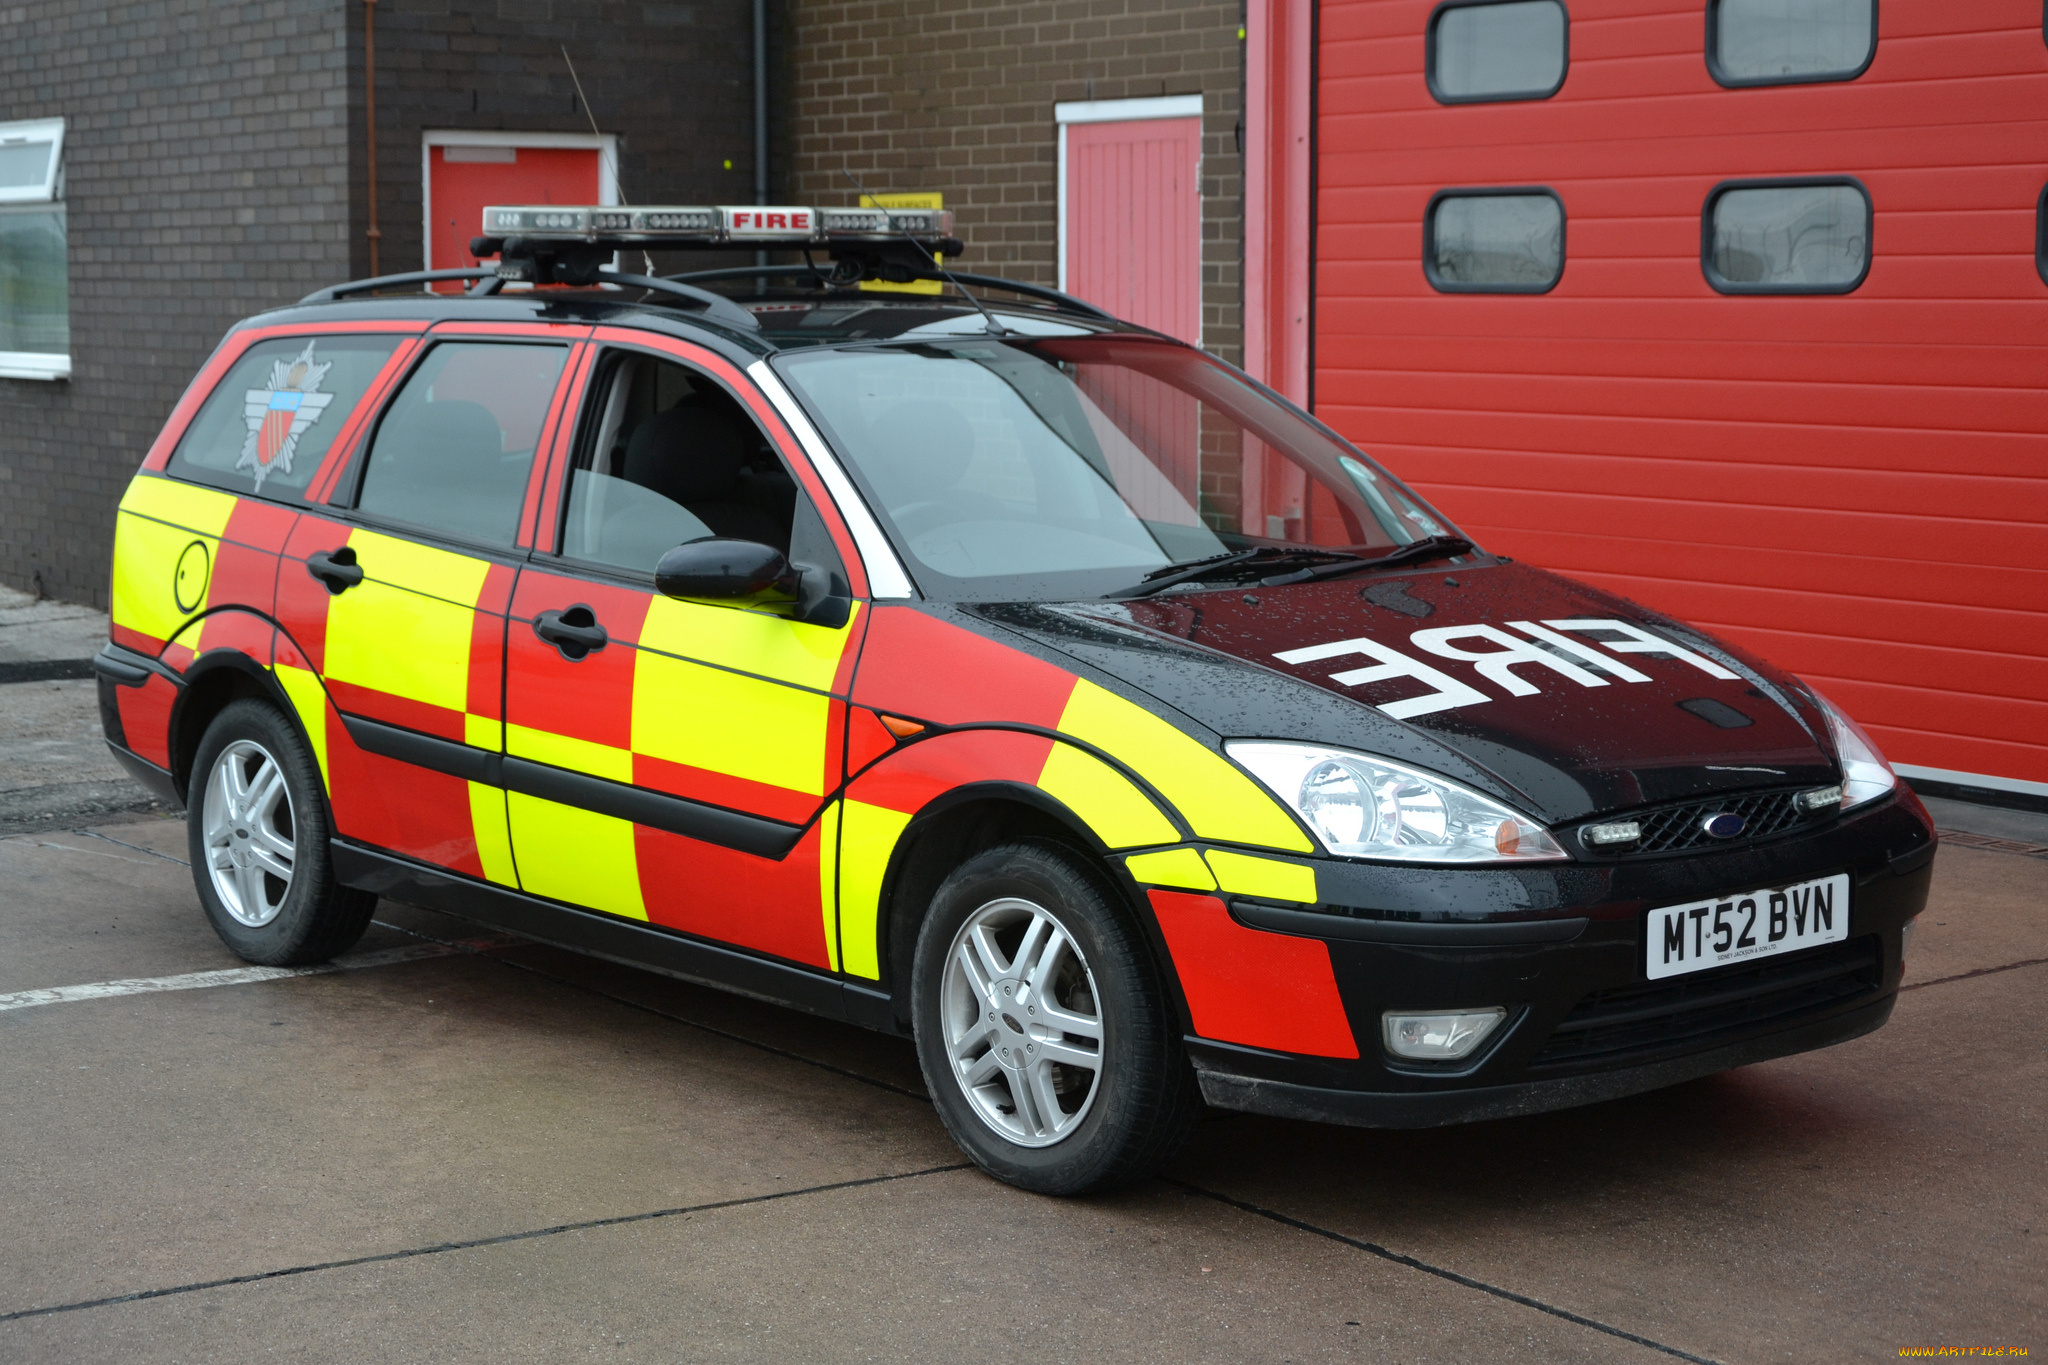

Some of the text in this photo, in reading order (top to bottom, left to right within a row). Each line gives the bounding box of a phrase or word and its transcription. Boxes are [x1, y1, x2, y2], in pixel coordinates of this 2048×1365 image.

[733, 212, 809, 229] FIRE
[1664, 883, 1833, 964] MT52 BVN
[1733, 948, 1754, 958] JACKSON
[1759, 945, 1768, 953] SON
